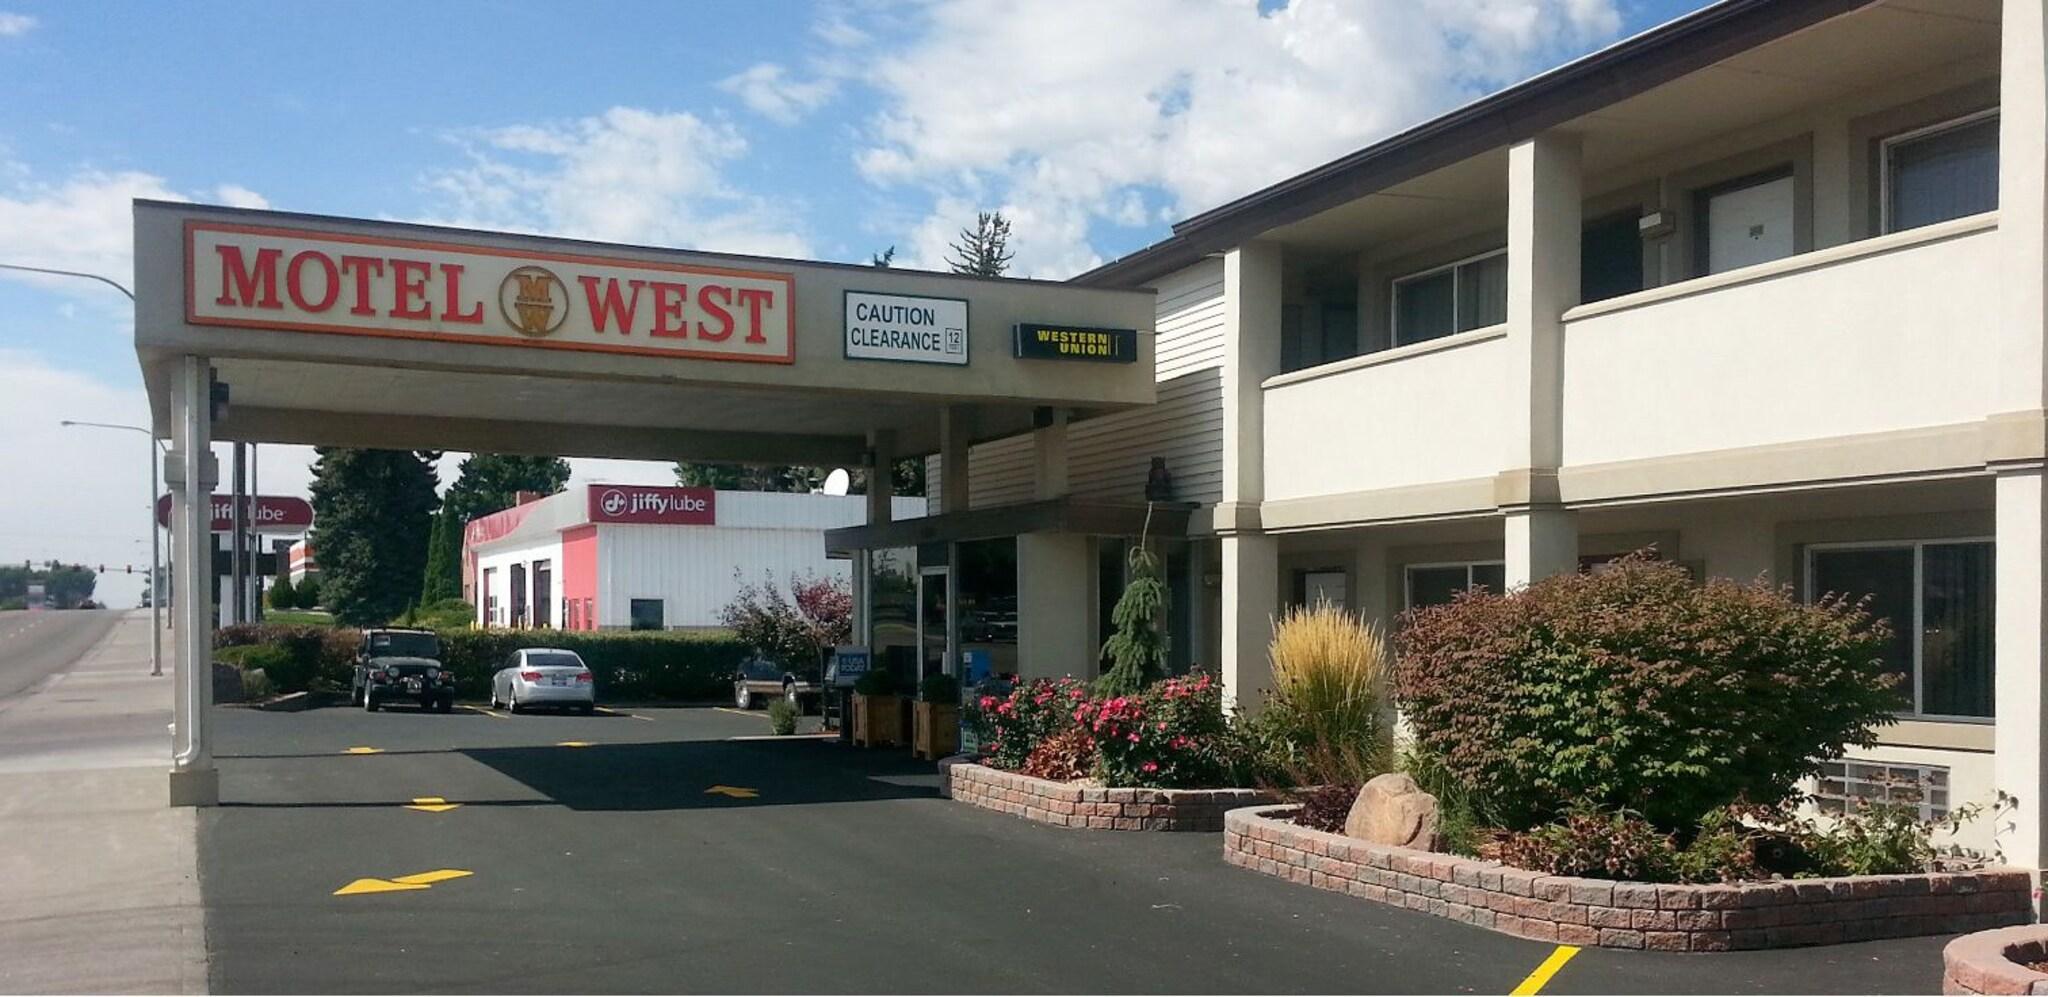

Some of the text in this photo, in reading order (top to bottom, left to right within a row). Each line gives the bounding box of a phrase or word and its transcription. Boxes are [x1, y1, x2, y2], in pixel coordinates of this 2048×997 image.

[215, 244, 774, 344] MOTEL WEST
[856, 303, 935, 326] CAUTION
[851, 327, 960, 351] CLEARANCE 12
[1037, 330, 1107, 345] WESTERN
[1060, 342, 1107, 355] UNION
